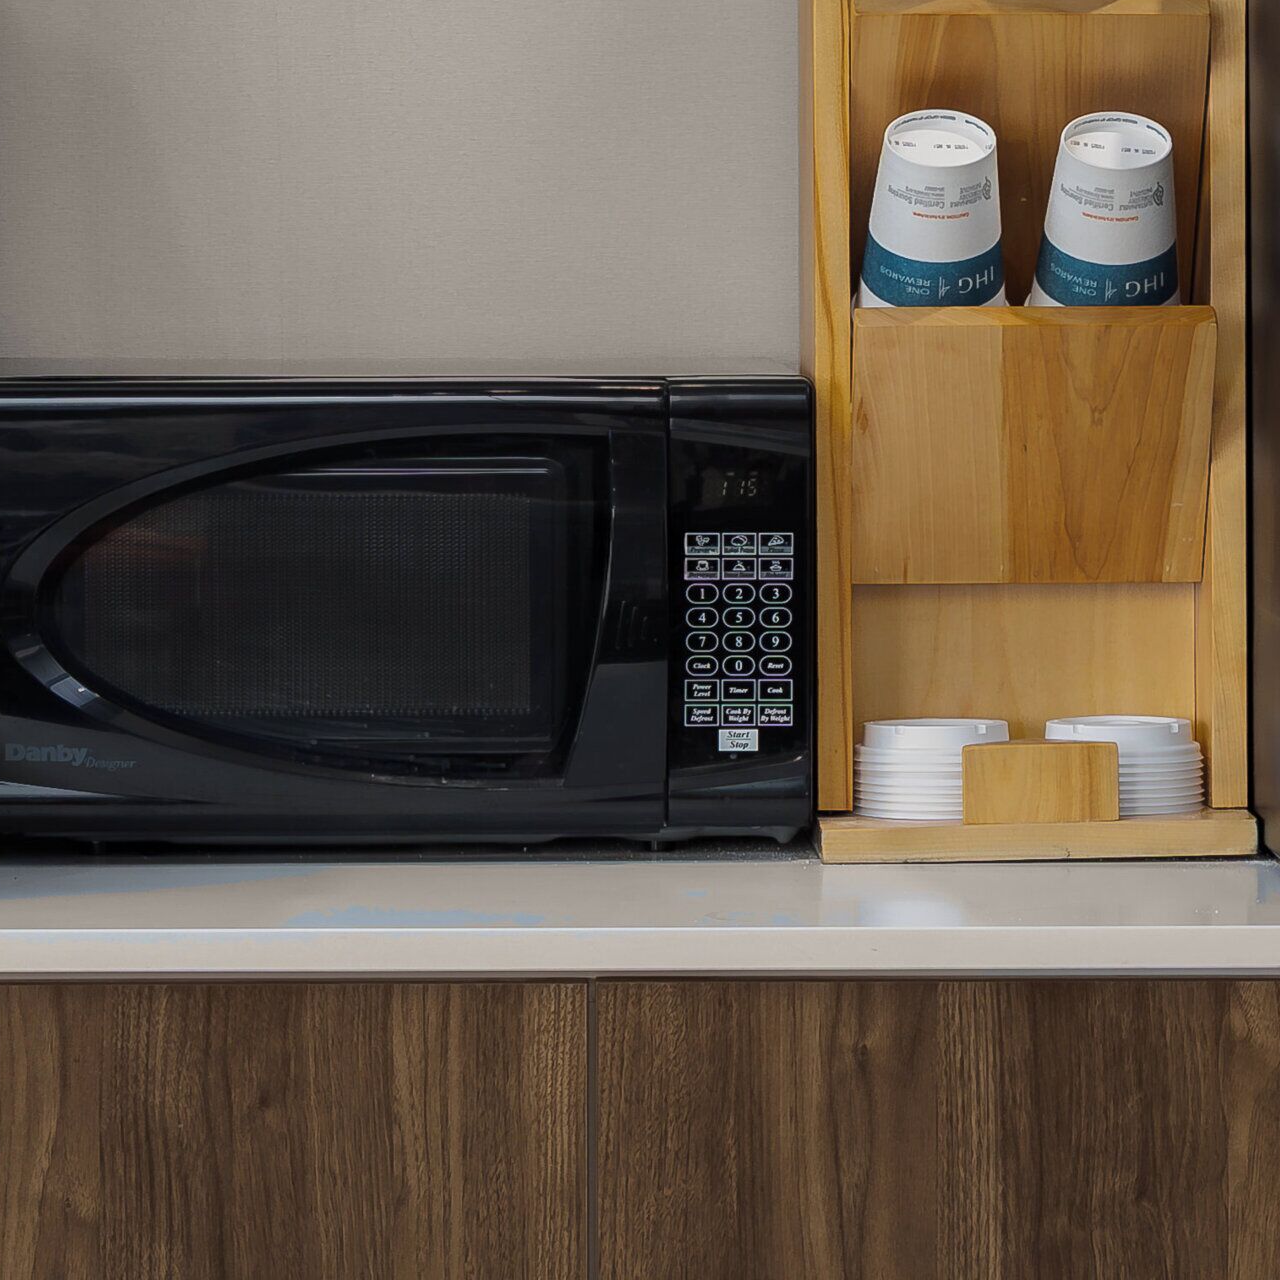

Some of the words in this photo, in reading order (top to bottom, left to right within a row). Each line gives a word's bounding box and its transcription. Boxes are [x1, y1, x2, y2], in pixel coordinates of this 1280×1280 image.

[880, 265, 931, 286] REWARDS
[959, 266, 994, 293] IHG
[1050, 263, 1097, 287] REWARDS
[905, 285, 930, 295] ONE
[1125, 272, 1164, 297] IHG
[1072, 285, 1096, 296] ONE
[700, 588, 705, 599] 1
[735, 588, 743, 599] 2
[772, 588, 779, 599] 3
[699, 612, 706, 623] 4
[735, 612, 743, 623] 5
[772, 612, 779, 623] 6
[699, 636, 706, 647] 7
[735, 636, 743, 647] 8
[772, 636, 779, 647] 9
[735, 660, 742, 671] 0
[730, 741, 749, 749] Stop
[5, 743, 88, 766] Danby
